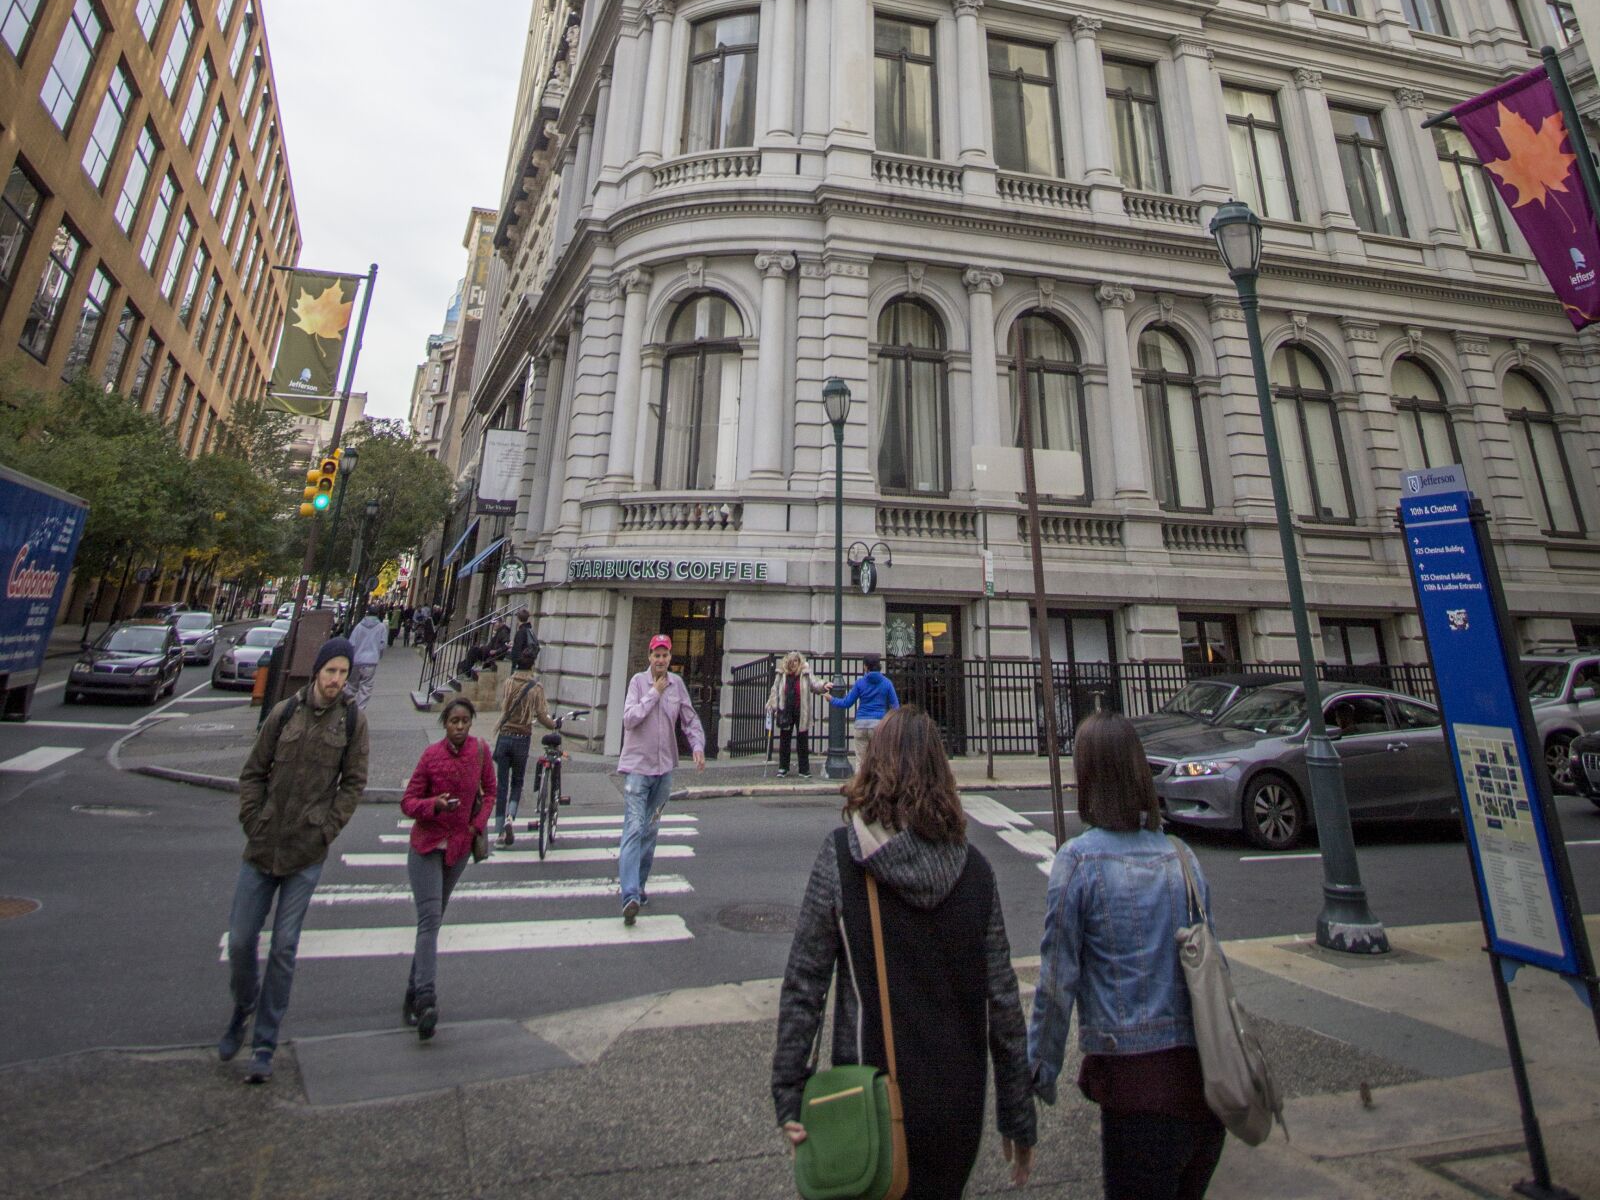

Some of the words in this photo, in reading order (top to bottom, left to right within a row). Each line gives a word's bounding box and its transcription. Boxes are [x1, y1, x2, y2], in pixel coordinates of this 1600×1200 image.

[288, 380, 318, 391] Jefferson
[1420, 474, 1456, 488] Jefferson
[1410, 506, 1424, 516] 10th
[1424, 506, 1430, 515] &
[1430, 504, 1458, 514] Chestnut
[1424, 546, 1445, 554] Chestnut
[1445, 545, 1465, 554] Building
[568, 559, 670, 580] STARBUCKS
[674, 561, 768, 580] COFFEE
[1430, 573, 1451, 581] Chestnut
[1451, 572, 1472, 581] Building
